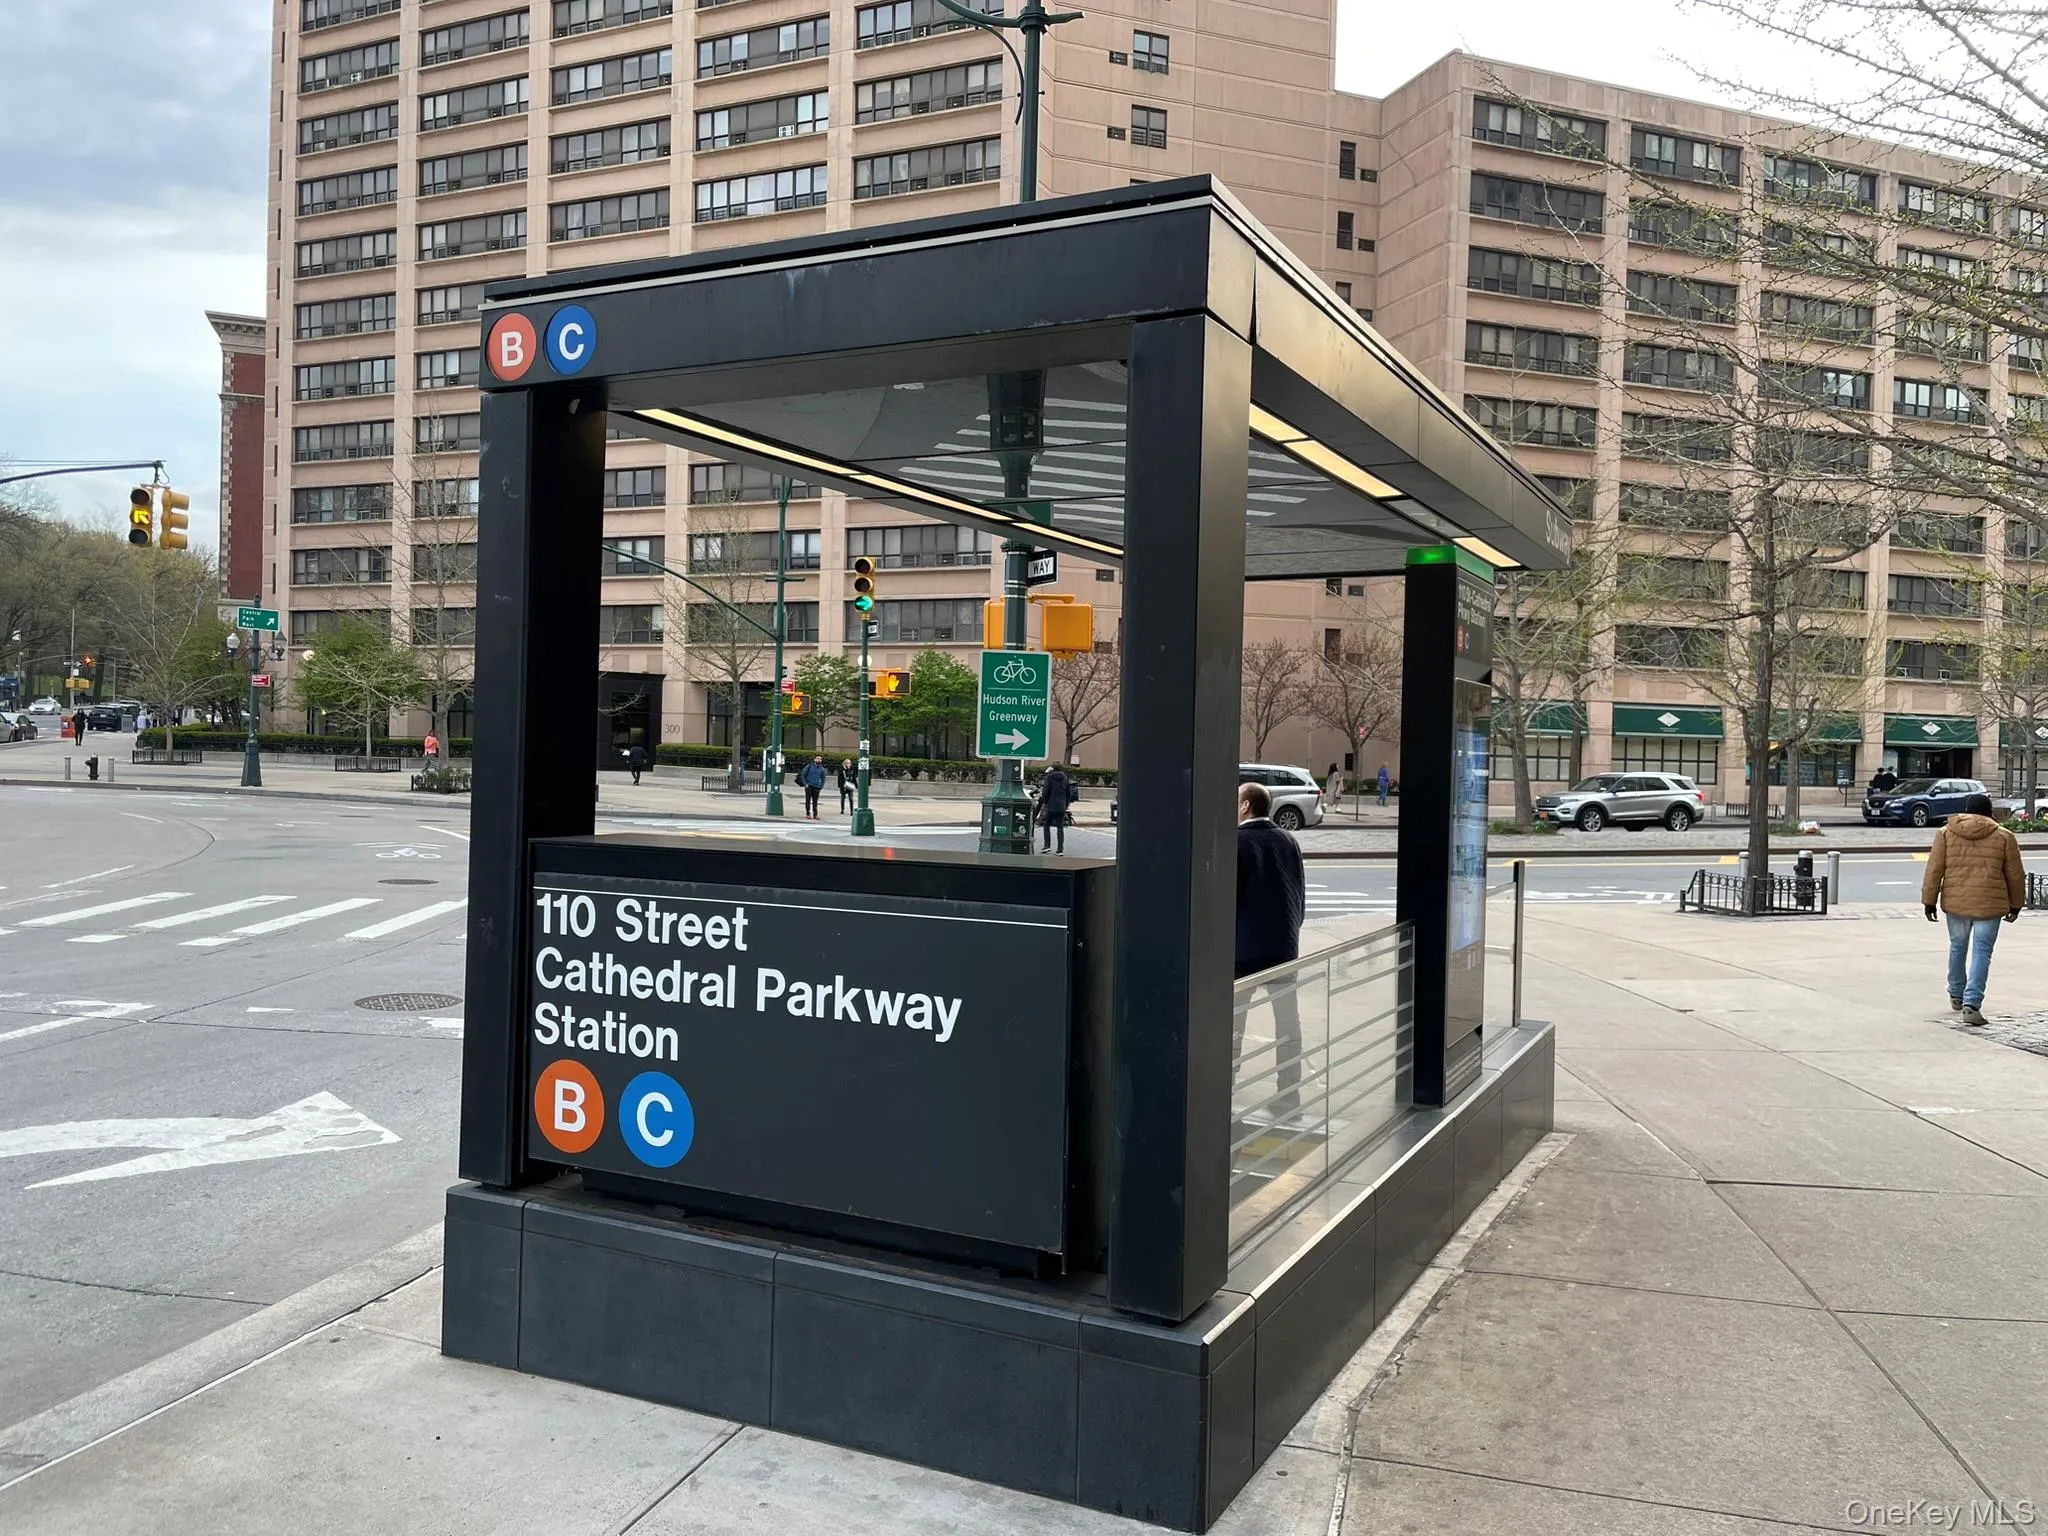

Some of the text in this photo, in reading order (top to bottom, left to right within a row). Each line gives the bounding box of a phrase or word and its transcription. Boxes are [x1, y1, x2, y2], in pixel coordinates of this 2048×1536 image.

[501, 322, 585, 368] B C
[1033, 559, 1051, 575] WAY
[982, 693, 1046, 707] Hudson River
[989, 710, 1038, 725] Greenway
[664, 723, 680, 734] 300
[536, 893, 748, 951] 110 Street
[535, 947, 962, 1042] Cathedral Parkway
[534, 1003, 679, 1061] Station
[554, 1079, 674, 1147] B C
